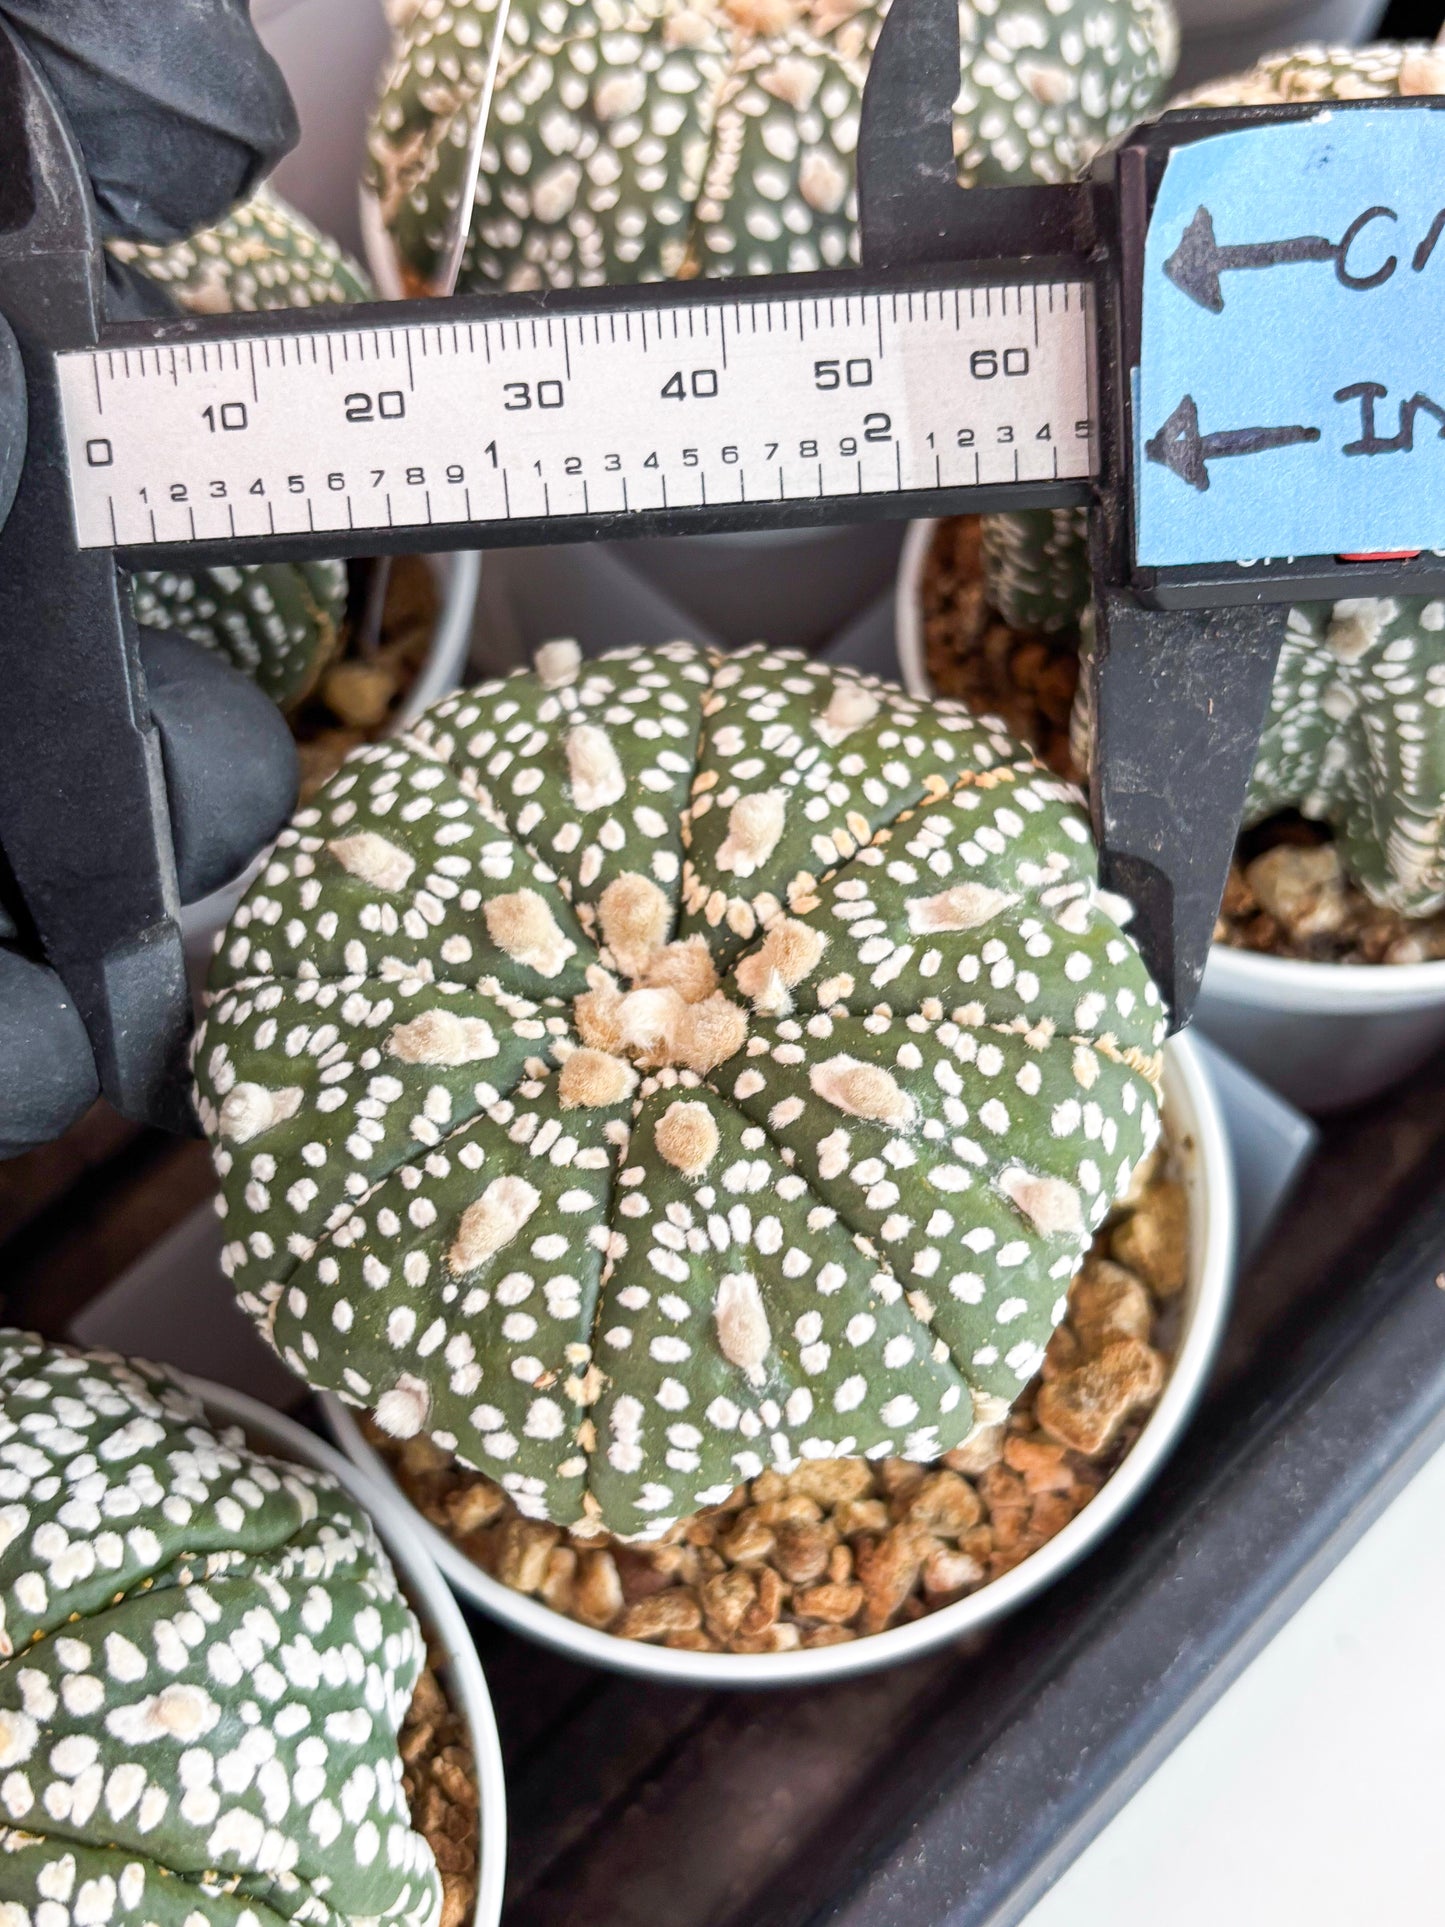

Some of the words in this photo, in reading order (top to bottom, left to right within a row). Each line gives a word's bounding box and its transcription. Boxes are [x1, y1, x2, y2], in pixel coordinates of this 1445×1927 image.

[85, 439, 113, 467] 0
[202, 402, 248, 433] 10
[344, 391, 405, 423] 20
[503, 380, 564, 411] 30
[661, 369, 718, 401] 40
[814, 358, 872, 390] 50
[970, 348, 1029, 380] 60
[139, 487, 147, 504] 1
[170, 484, 188, 502] 2
[209, 481, 227, 498] 3
[249, 478, 265, 496] 4
[288, 475, 304, 493] 5
[328, 473, 345, 491] 6
[370, 470, 385, 487] 7
[406, 467, 425, 485] 8
[446, 465, 464, 484] 9
[484, 440, 498, 468] 1
[534, 460, 541, 477] 1
[564, 457, 582, 475] 2
[605, 454, 621, 471] 3
[643, 452, 659, 469] 4
[683, 448, 698, 467] 5
[721, 446, 739, 464] 6
[765, 443, 779, 460] 7
[800, 440, 818, 458] 8
[839, 437, 857, 456] 9
[863, 413, 892, 442] 2
[926, 432, 934, 449] 1
[957, 429, 974, 447] 2
[997, 426, 1014, 443] 3
[1036, 423, 1052, 441] 4
[1075, 420, 1092, 438] 5
